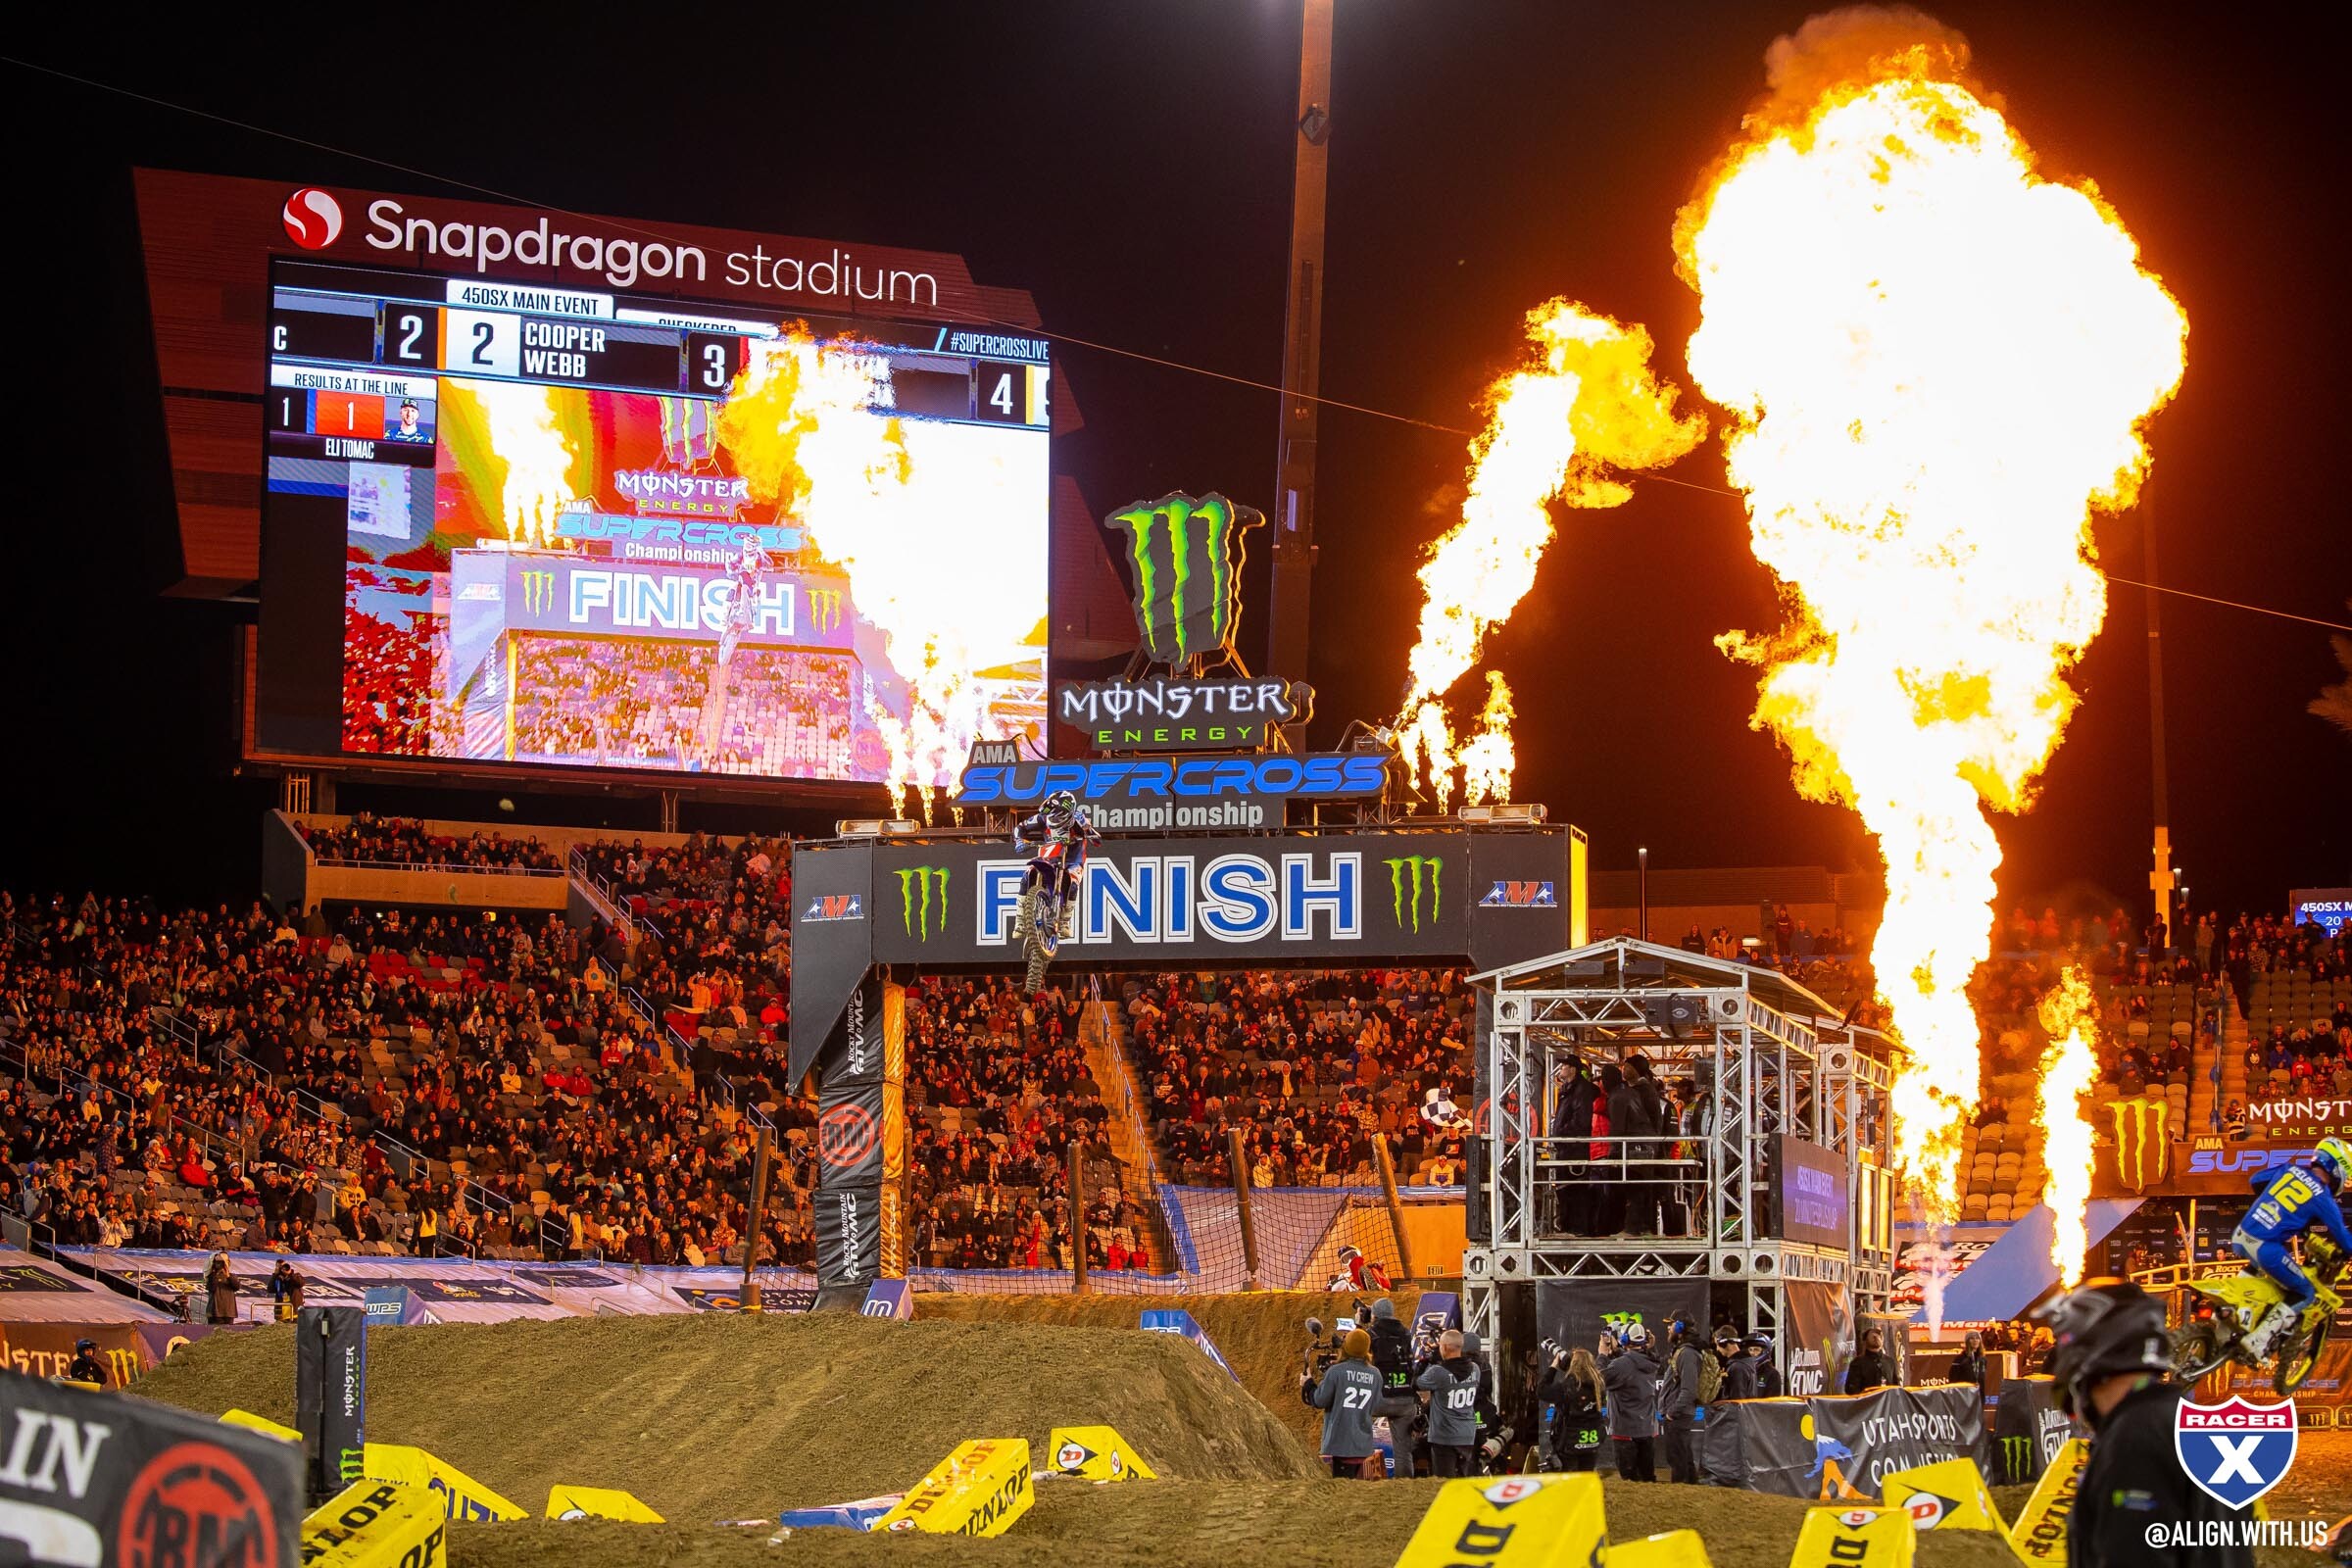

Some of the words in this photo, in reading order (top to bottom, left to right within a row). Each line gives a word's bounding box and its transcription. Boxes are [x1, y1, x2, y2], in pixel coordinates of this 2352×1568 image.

[366, 199, 706, 287] Snapdragon
[725, 244, 937, 306] stadium
[462, 286, 509, 307] 450SX
[513, 291, 550, 312] MAIN
[555, 295, 599, 316] EVENT
[399, 315, 423, 360] 2
[471, 321, 494, 366] 2
[524, 322, 606, 353] COOPER
[524, 349, 586, 377] WEBB
[703, 344, 725, 388] 3
[294, 372, 342, 390] RESULTS
[345, 377, 358, 391] AT
[362, 378, 381, 393] THE
[384, 380, 409, 396] LINE
[990, 372, 1013, 415] 4
[282, 397, 289, 426] 1
[347, 401, 354, 431] 1
[325, 438, 339, 457] ELI
[341, 439, 374, 459] TOMAC
[617, 472, 751, 499] MONSTER
[639, 499, 728, 513] ENERGY
[1061, 680, 1290, 723] MONSTER
[1098, 725, 1253, 744] ENERGY
[971, 744, 1017, 764] AMA
[956, 756, 1391, 803] SUPERCROSS
[976, 851, 1362, 946] FNISH
[1478, 880, 1558, 904] AMA
[801, 895, 864, 919] AMA
[2300, 902, 2342, 912] 450SX
[2195, 1138, 2224, 1151] AMA
[2268, 1172, 2313, 1213] 12
[840, 1193, 850, 1240] MOUNTAIN
[366, 1301, 402, 1316] WPS
[343, 1345, 356, 1417] MONSTER
[1347, 1370, 1355, 1382] TV
[1356, 1371, 1374, 1385] CREW
[1343, 1387, 1372, 1409] 27
[1447, 1387, 1477, 1408] 100
[1579, 1430, 1598, 1444] 38
[957, 1462, 1029, 1537] UNLOP
